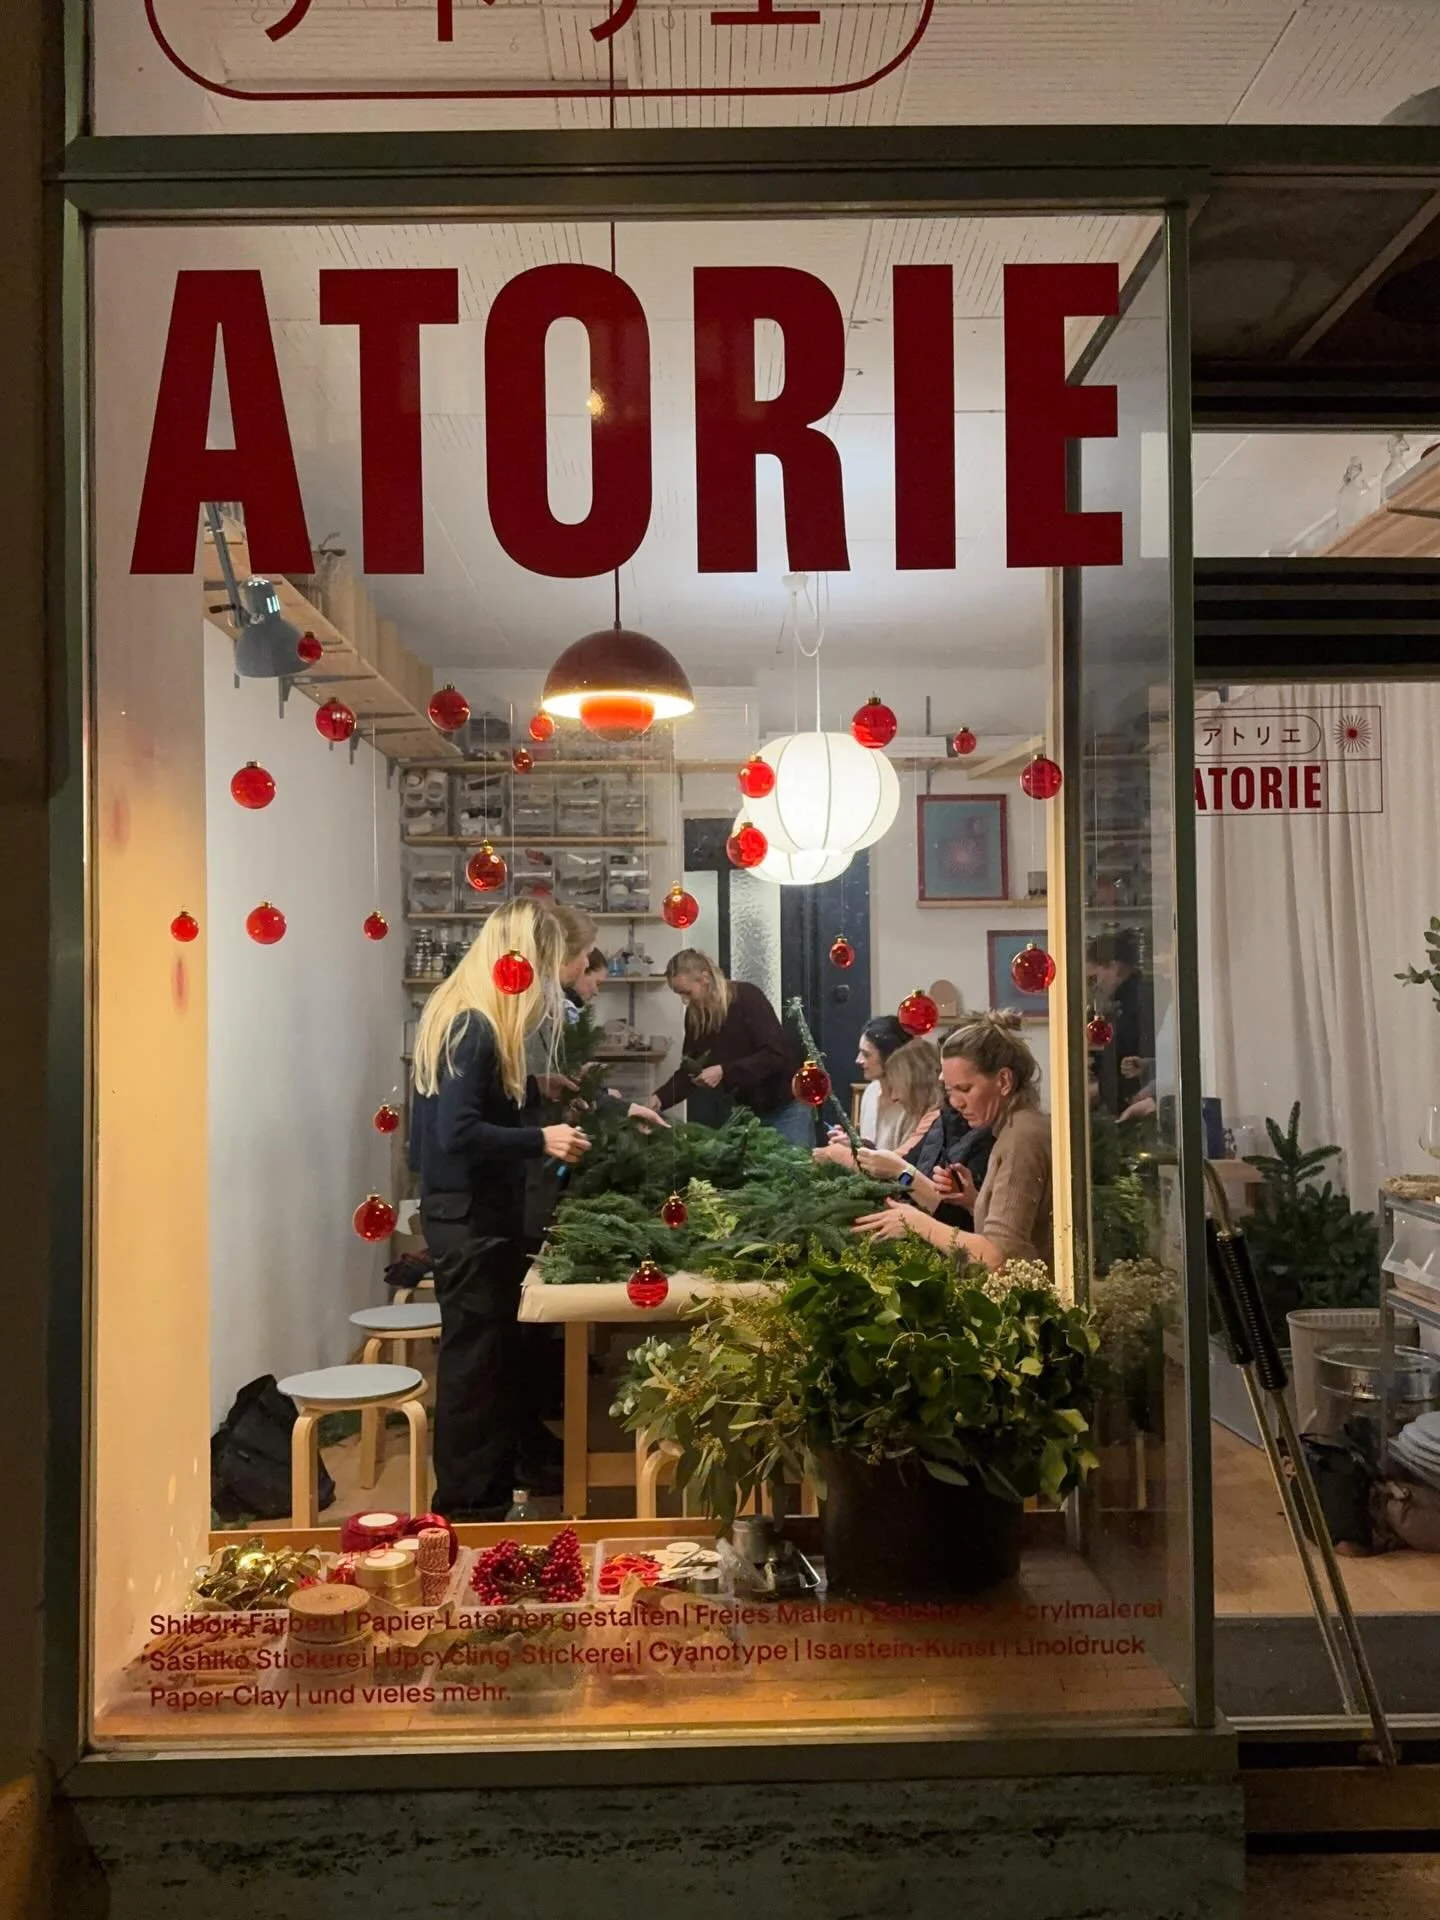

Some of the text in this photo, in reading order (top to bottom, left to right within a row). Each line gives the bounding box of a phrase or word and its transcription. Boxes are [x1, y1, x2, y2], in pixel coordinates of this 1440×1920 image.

[130, 262, 1124, 579] ATORIE
[1203, 726, 1301, 746] アトリエ
[563, 1604, 680, 1632] gestalten
[696, 1604, 768, 1626] Freies
[777, 1602, 852, 1624] Malen
[150, 1649, 249, 1672] Sashiko
[256, 1646, 367, 1670] Stickerei
[649, 1640, 788, 1667] Cyanotype
[806, 1638, 995, 1660] Isarstein-Kunst
[150, 1680, 512, 1711] Paper-Clay und vieles mehr.
